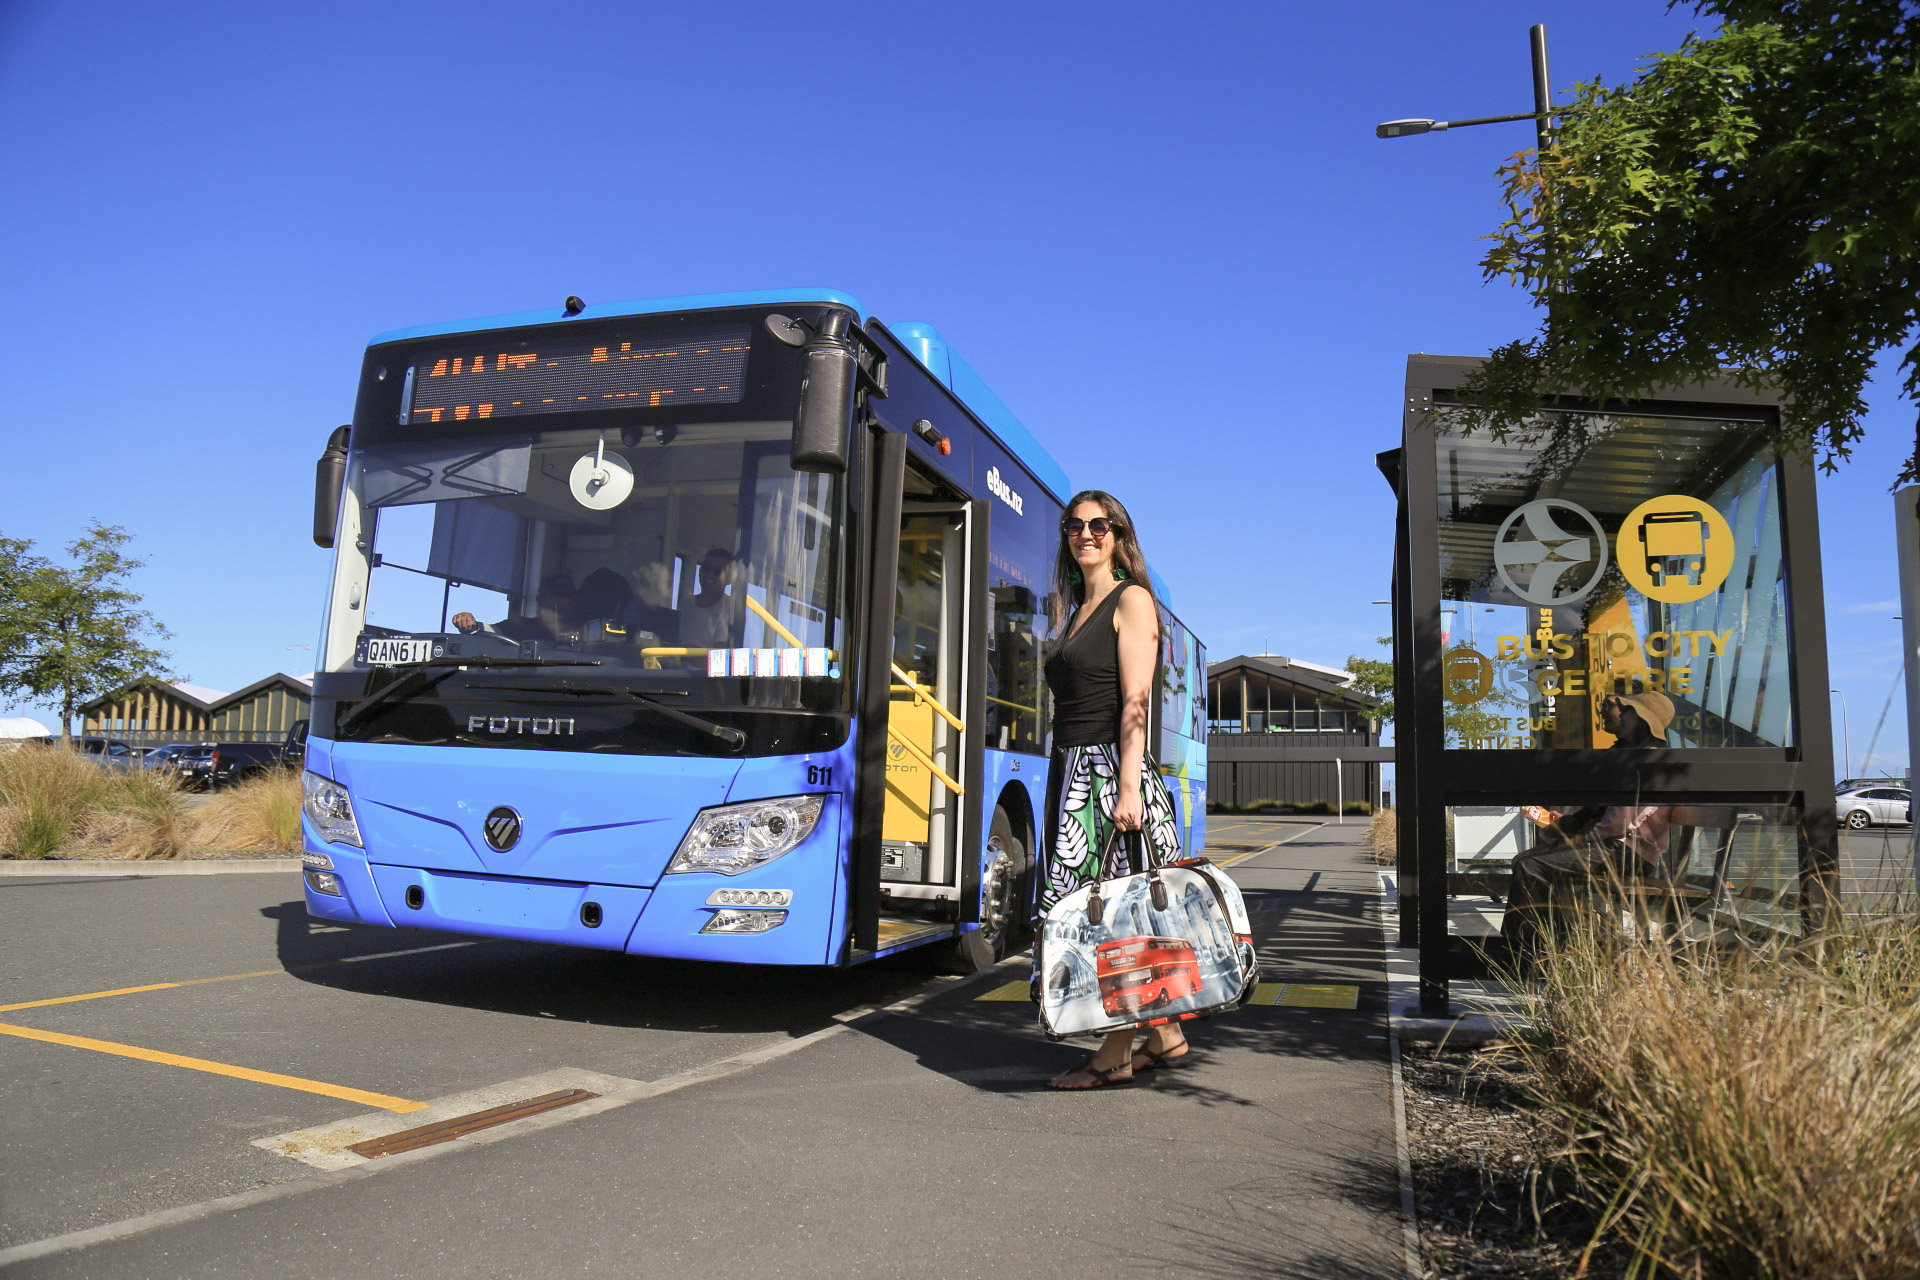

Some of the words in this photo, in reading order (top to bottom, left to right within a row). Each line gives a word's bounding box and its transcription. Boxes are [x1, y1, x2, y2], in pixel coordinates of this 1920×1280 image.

[987, 466, 1023, 517] eBus.nz
[369, 641, 428, 662] QAN611
[1496, 633, 1576, 661] BUS
[1582, 632, 1635, 659] TO
[1645, 630, 1734, 658] CITY
[1536, 667, 1694, 696] CENTRE
[468, 716, 575, 735] FOTON
[807, 765, 833, 786] 611
[885, 764, 918, 773] OTON
